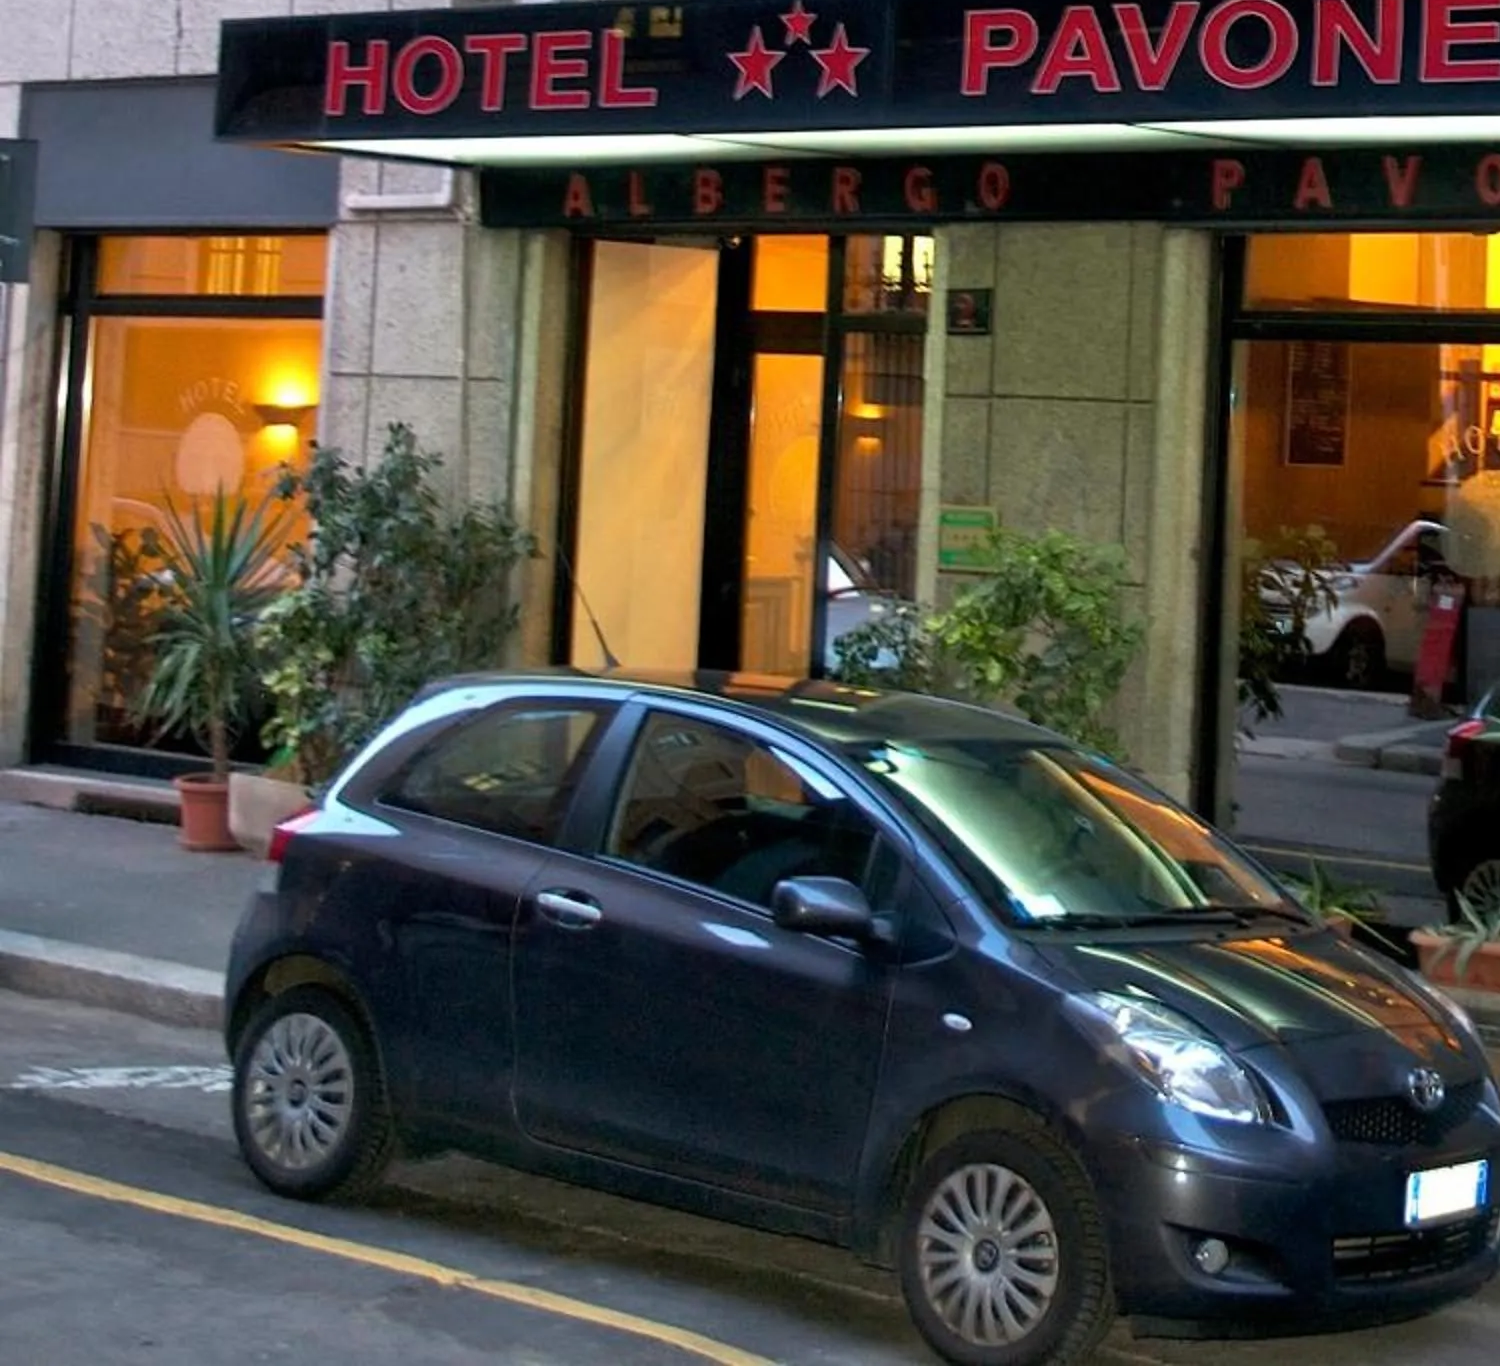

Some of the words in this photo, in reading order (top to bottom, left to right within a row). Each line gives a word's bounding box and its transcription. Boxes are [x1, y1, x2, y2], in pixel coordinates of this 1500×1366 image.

[323, 29, 659, 117] HOTEL
[563, 161, 1011, 217] ALBERGO
[179, 376, 246, 416] HOTEL
